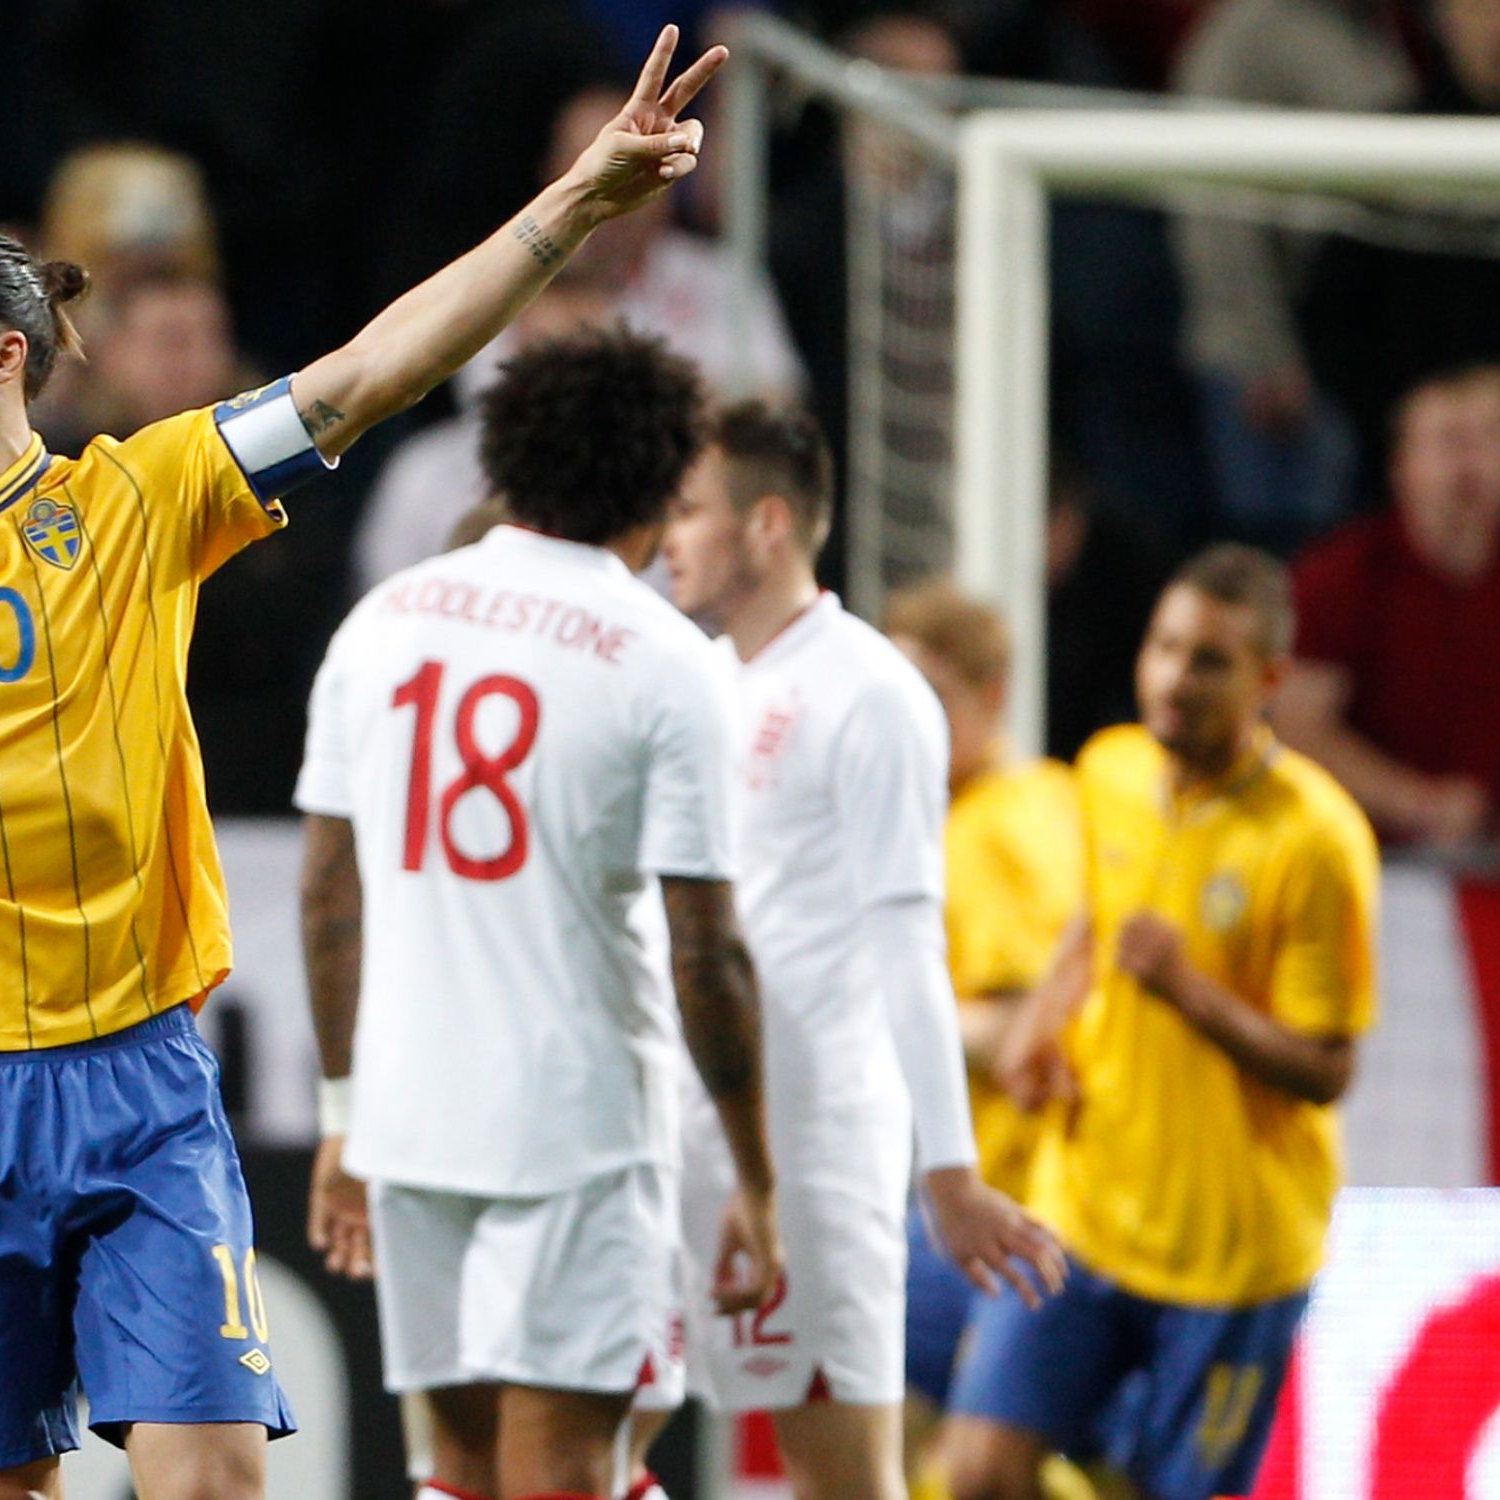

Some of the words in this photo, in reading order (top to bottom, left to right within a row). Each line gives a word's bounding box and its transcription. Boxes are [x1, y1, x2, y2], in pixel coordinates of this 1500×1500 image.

[381, 579, 639, 664] UDDLESTONE
[392, 660, 541, 882] 18
[212, 1244, 269, 1344] 10
